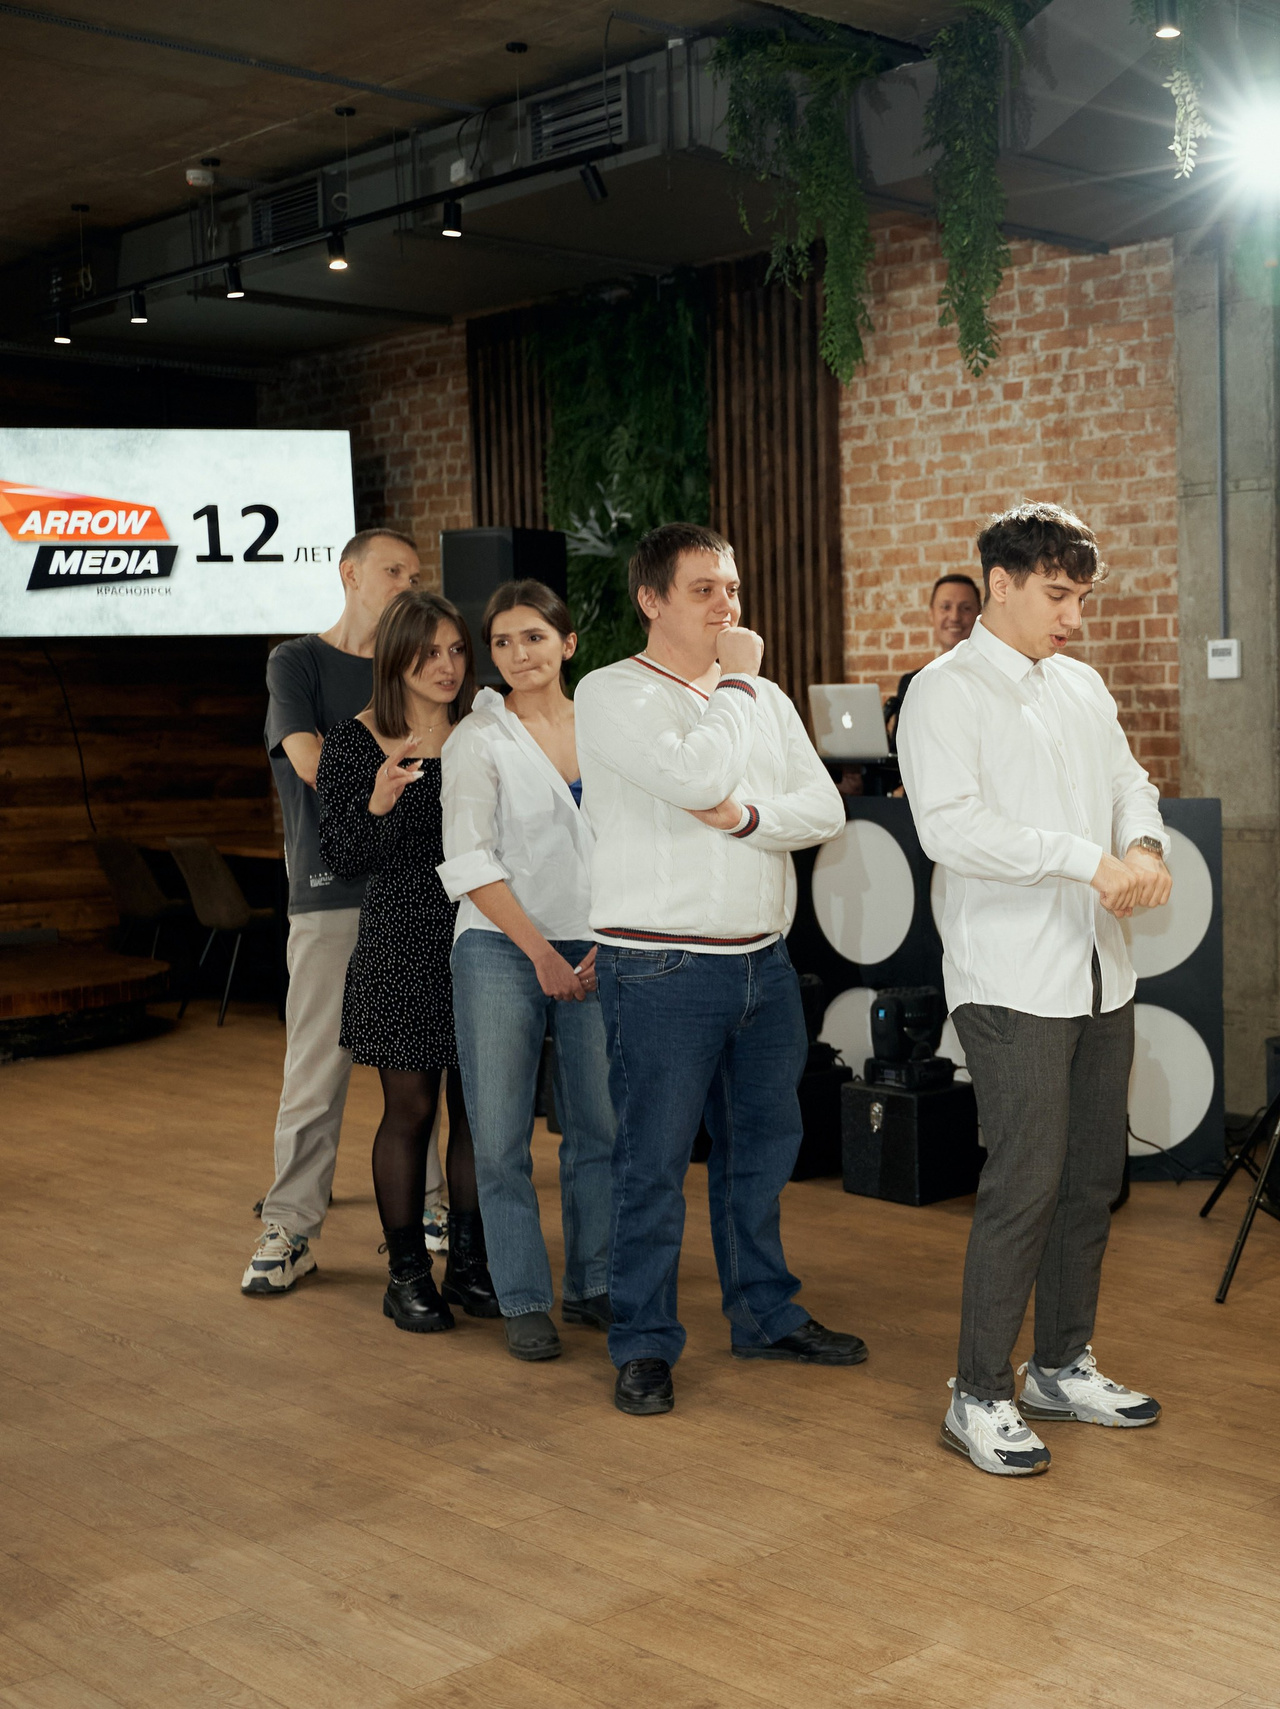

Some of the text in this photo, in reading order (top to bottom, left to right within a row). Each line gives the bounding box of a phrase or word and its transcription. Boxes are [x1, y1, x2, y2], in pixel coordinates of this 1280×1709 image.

[18, 510, 152, 535] ARROW
[193, 504, 335, 562] 12 ЛЕТ
[49, 550, 159, 575] MEDIA
[96, 585, 172, 597] КРАСНОЯРСК
